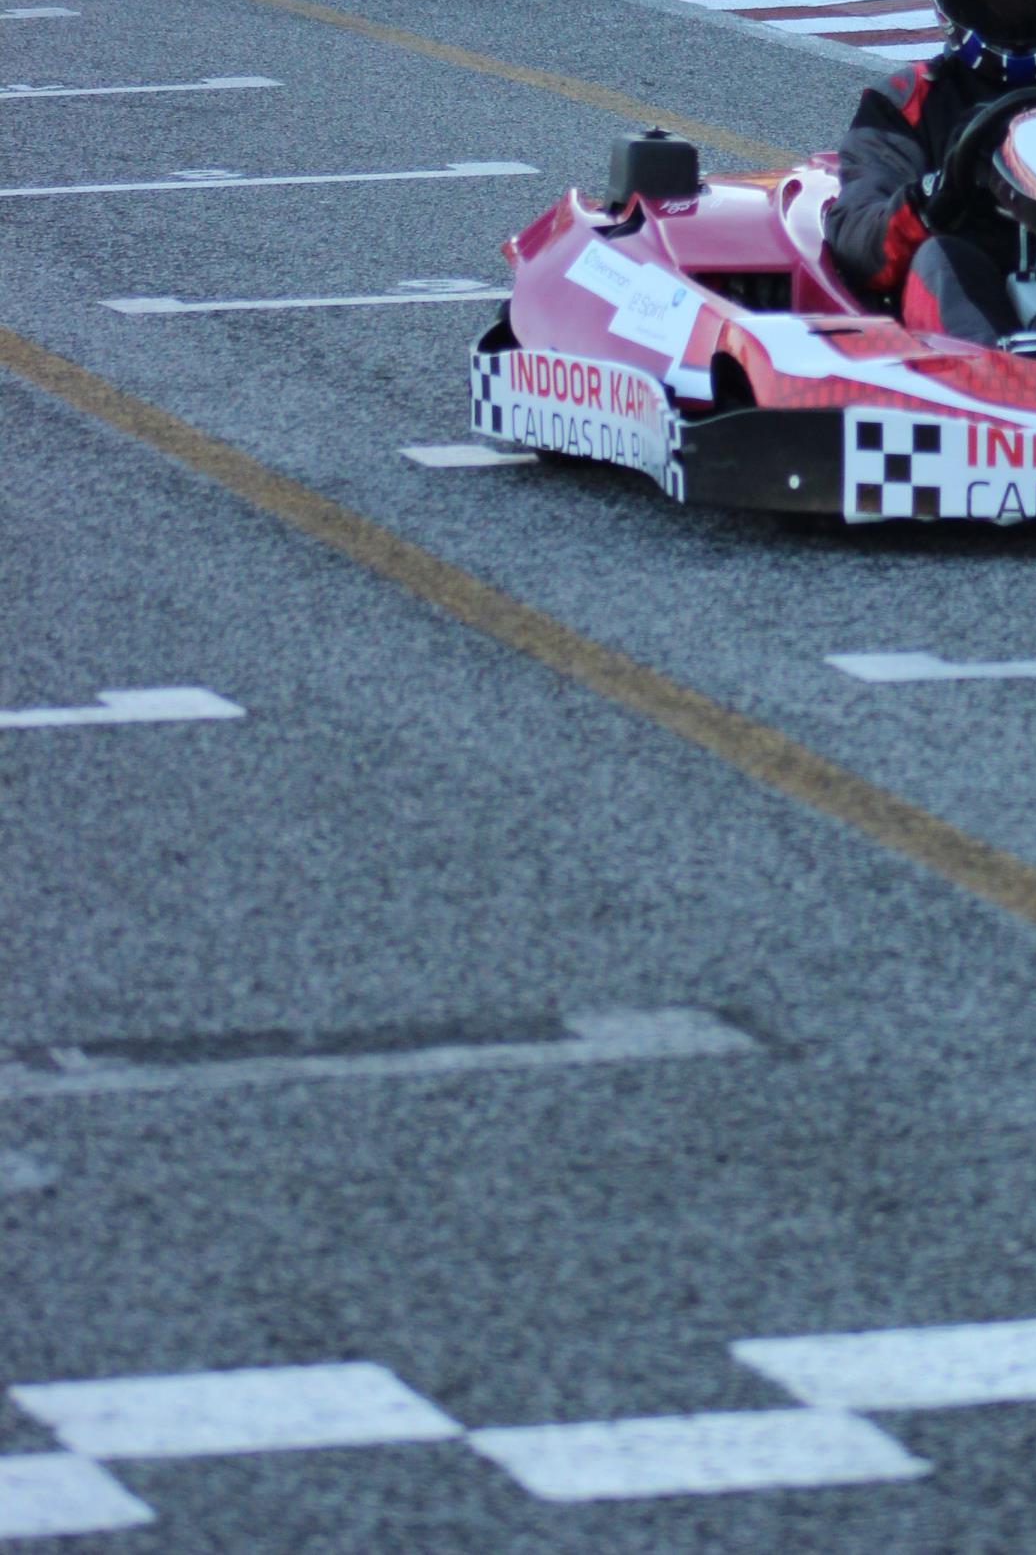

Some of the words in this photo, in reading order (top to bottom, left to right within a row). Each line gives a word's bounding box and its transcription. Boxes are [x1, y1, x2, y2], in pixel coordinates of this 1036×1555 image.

[510, 349, 602, 411] INDOOR
[512, 404, 593, 458] CALDAS
[601, 424, 626, 465] DA
